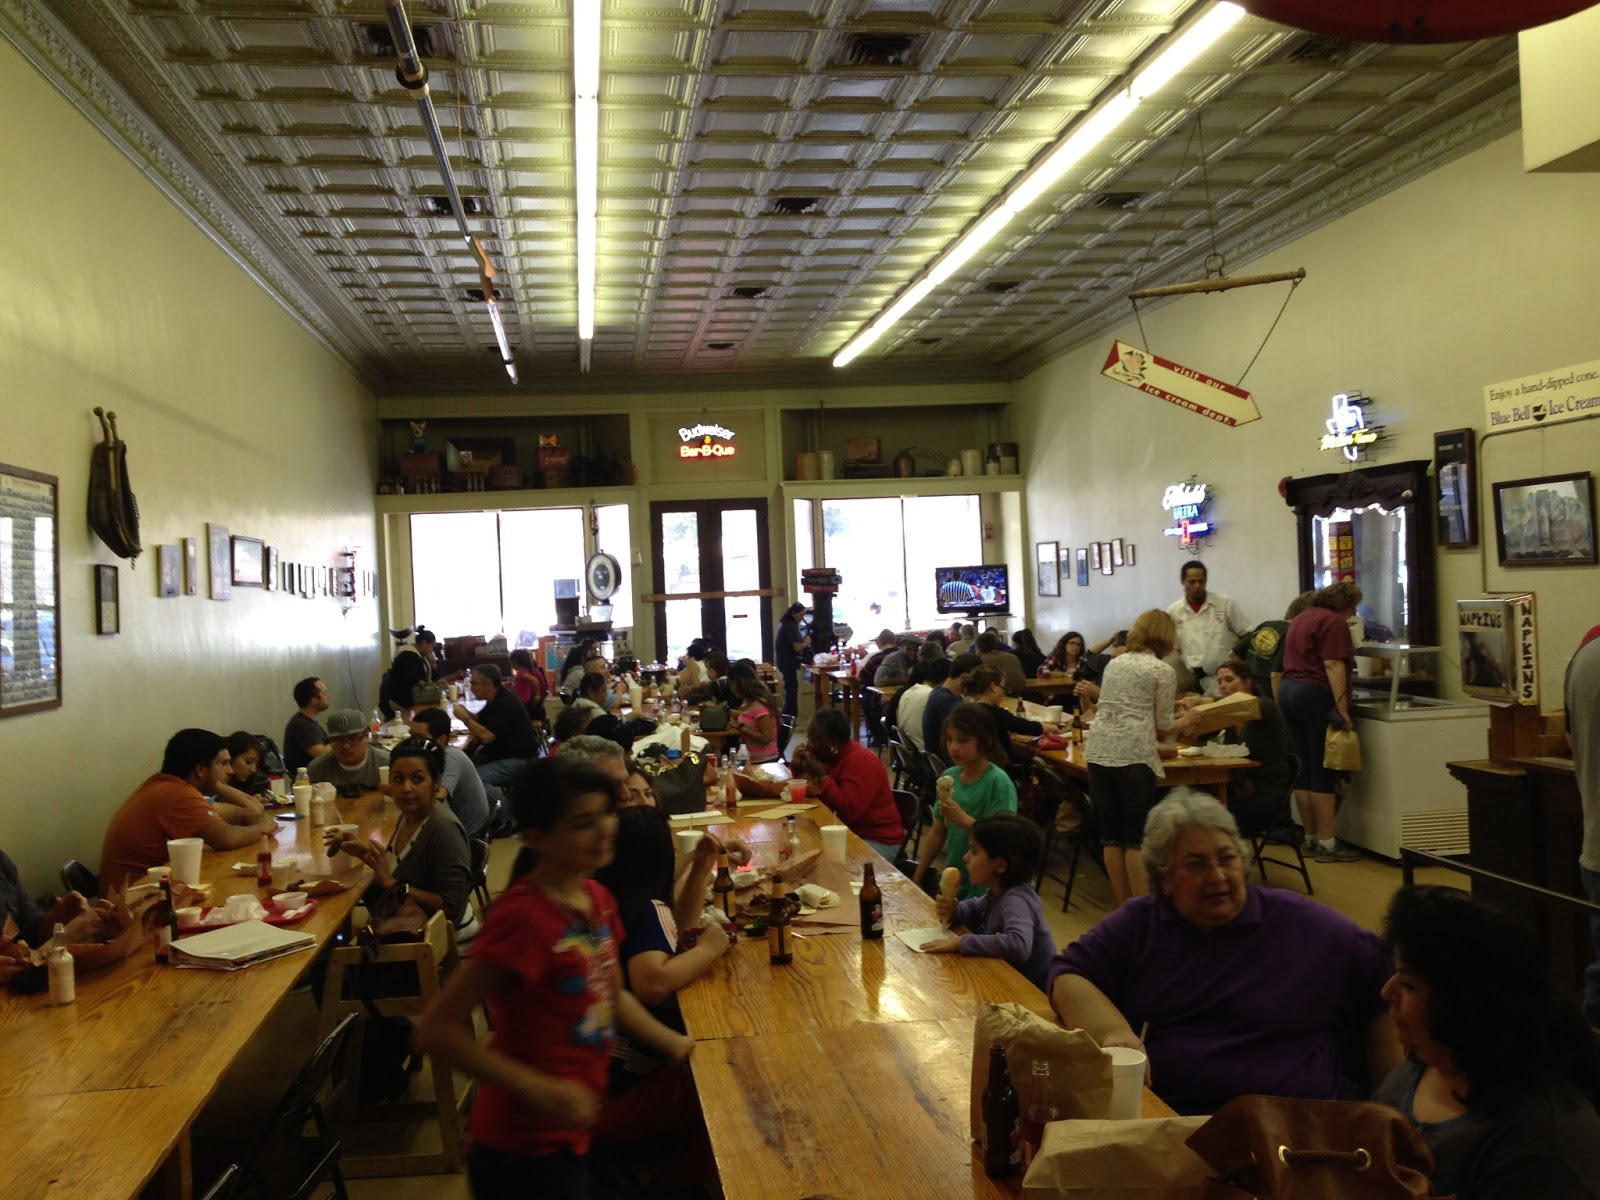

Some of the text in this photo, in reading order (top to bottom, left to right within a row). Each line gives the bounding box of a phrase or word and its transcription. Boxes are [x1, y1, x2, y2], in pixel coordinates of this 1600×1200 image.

[1173, 365, 1226, 391] visit our
[1489, 388, 1513, 402] Enjoy
[1514, 388, 1521, 396] a
[1521, 372, 1575, 395] hand-dipped
[1144, 384, 1232, 426] ice cream dept.
[1490, 395, 1600, 426] Blue Bell Ice Cream
[678, 423, 736, 442] Budweiser
[704, 435, 712, 444] &
[1460, 611, 1503, 629] NAPKINS
[1520, 601, 1535, 699] NAPKINS
